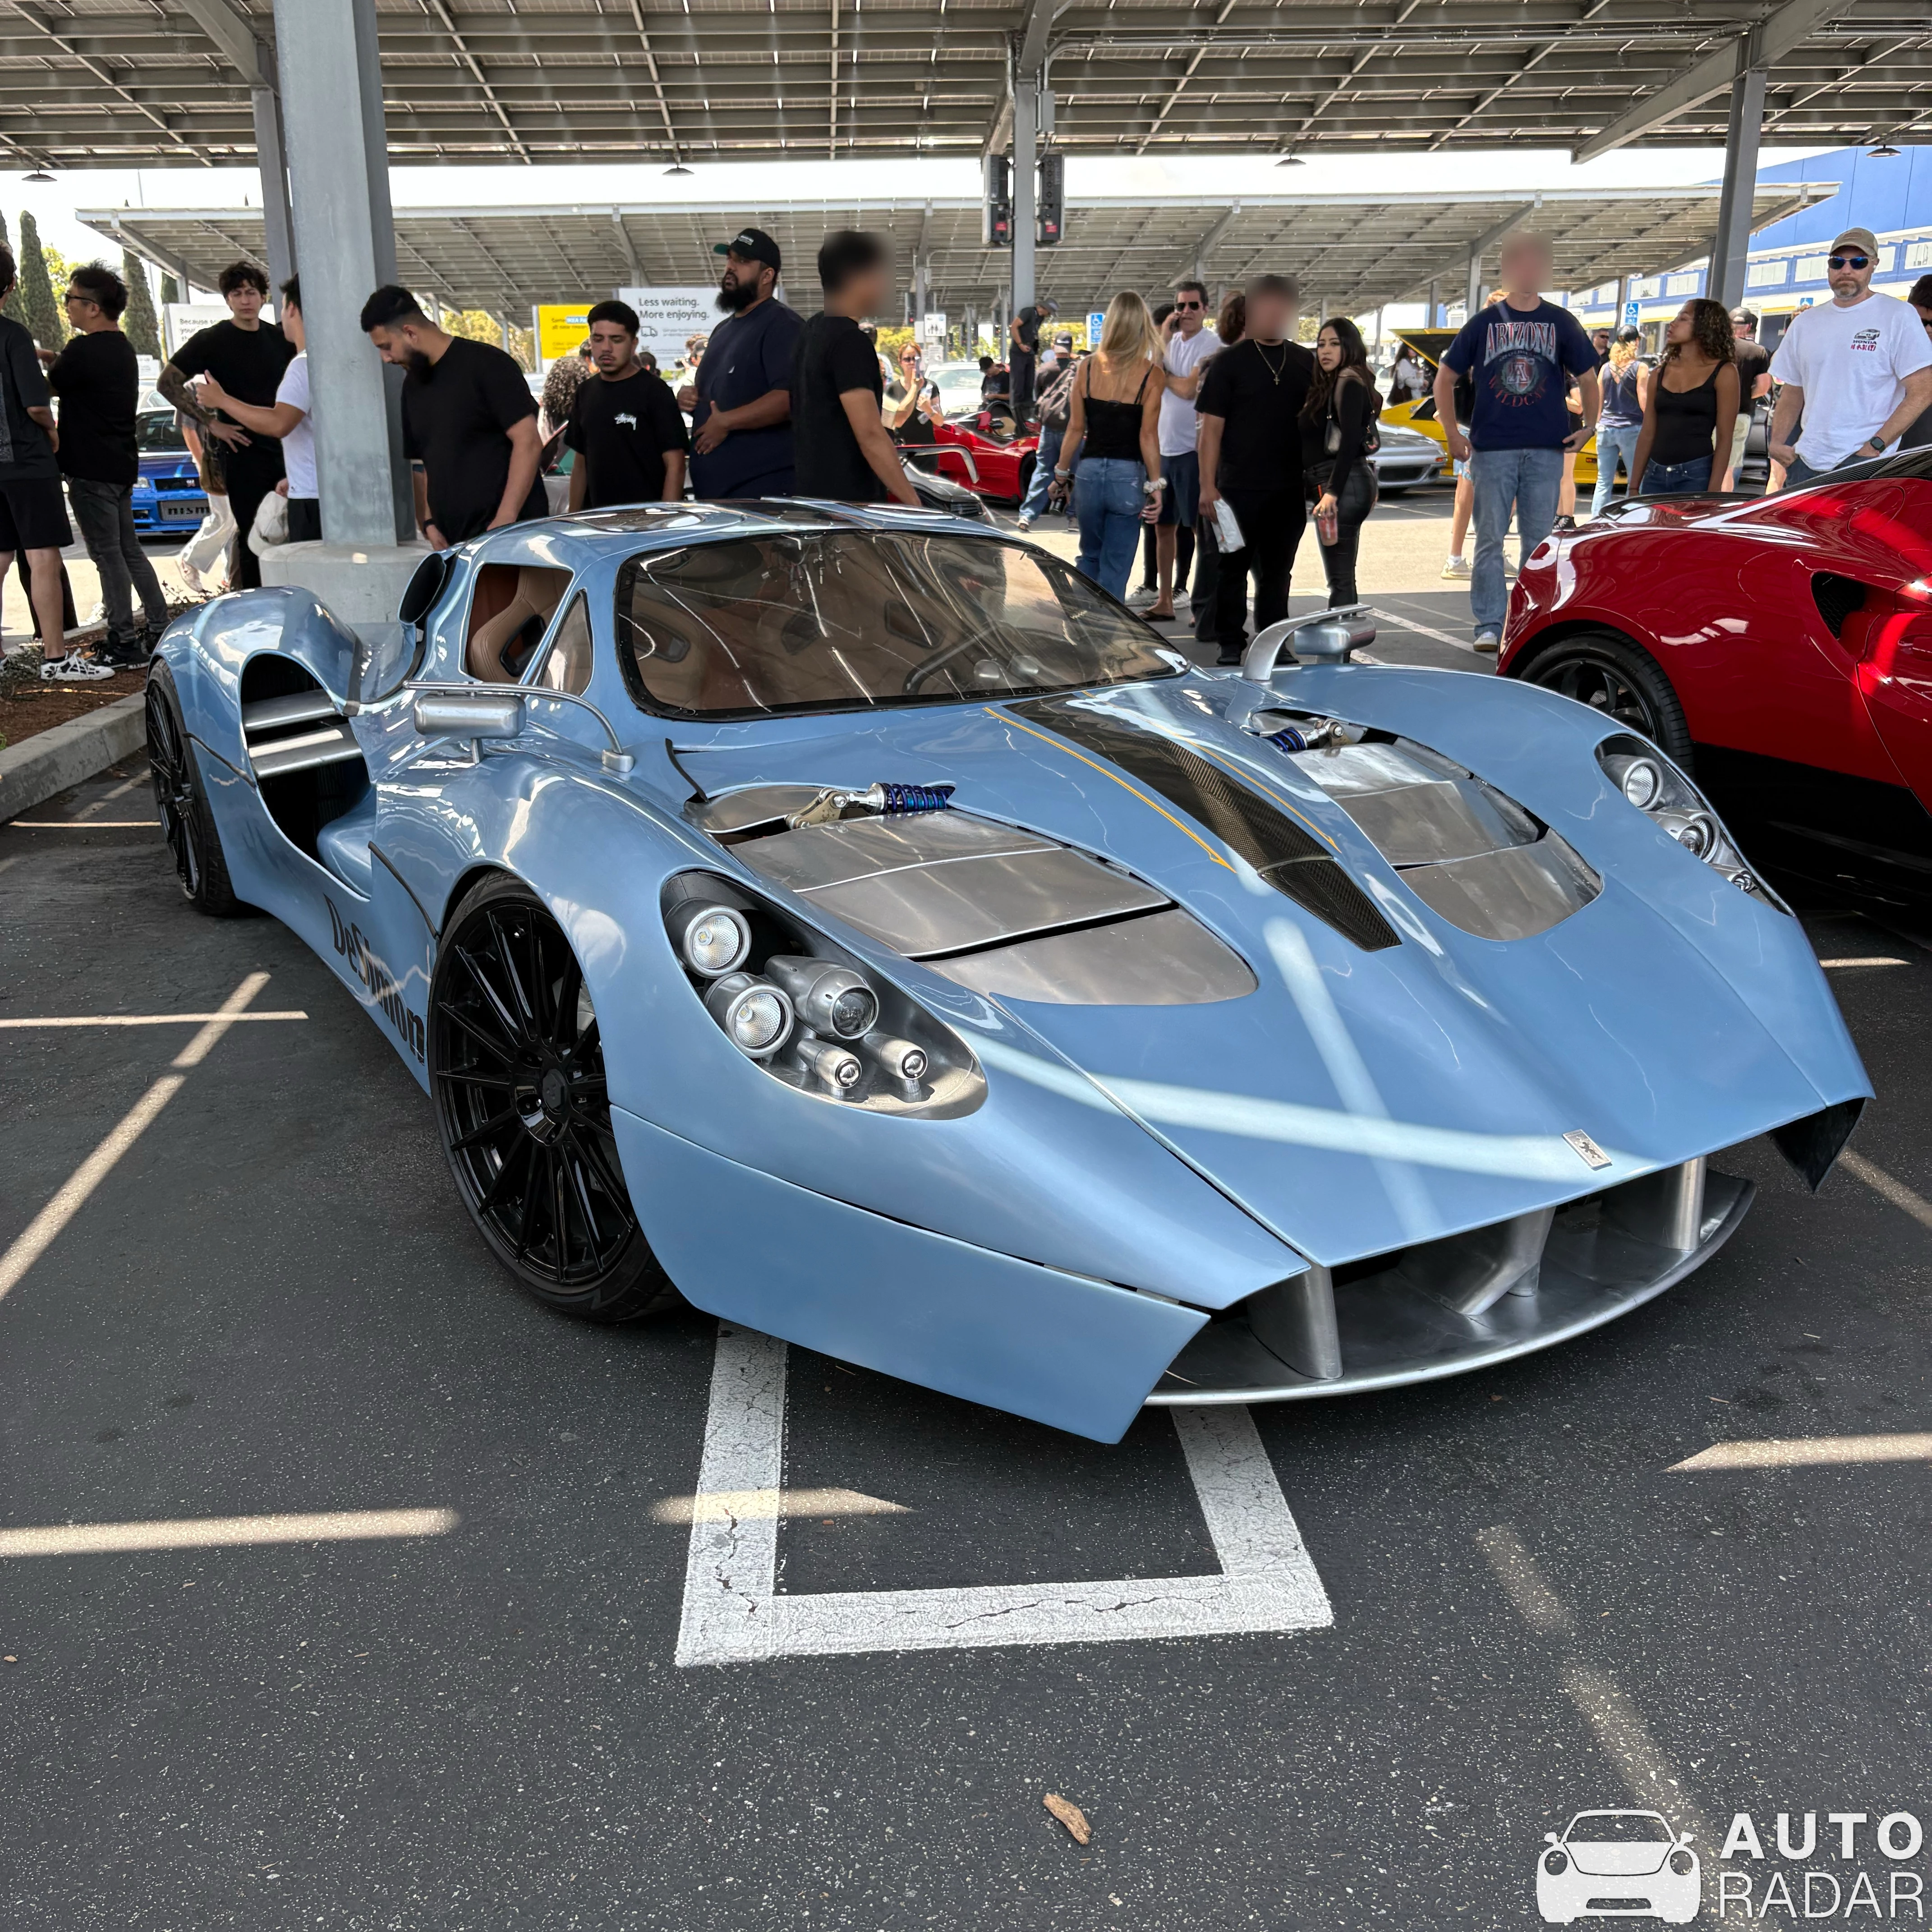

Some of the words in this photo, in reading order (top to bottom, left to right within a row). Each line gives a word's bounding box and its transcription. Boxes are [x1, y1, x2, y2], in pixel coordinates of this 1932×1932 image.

[639, 298, 659, 306] Less
[661, 297, 699, 308] waiting.
[639, 310, 664, 318] More
[667, 310, 710, 321] enjoying.
[1483, 322, 1556, 367] ARIZONA
[168, 507, 210, 515] nism
